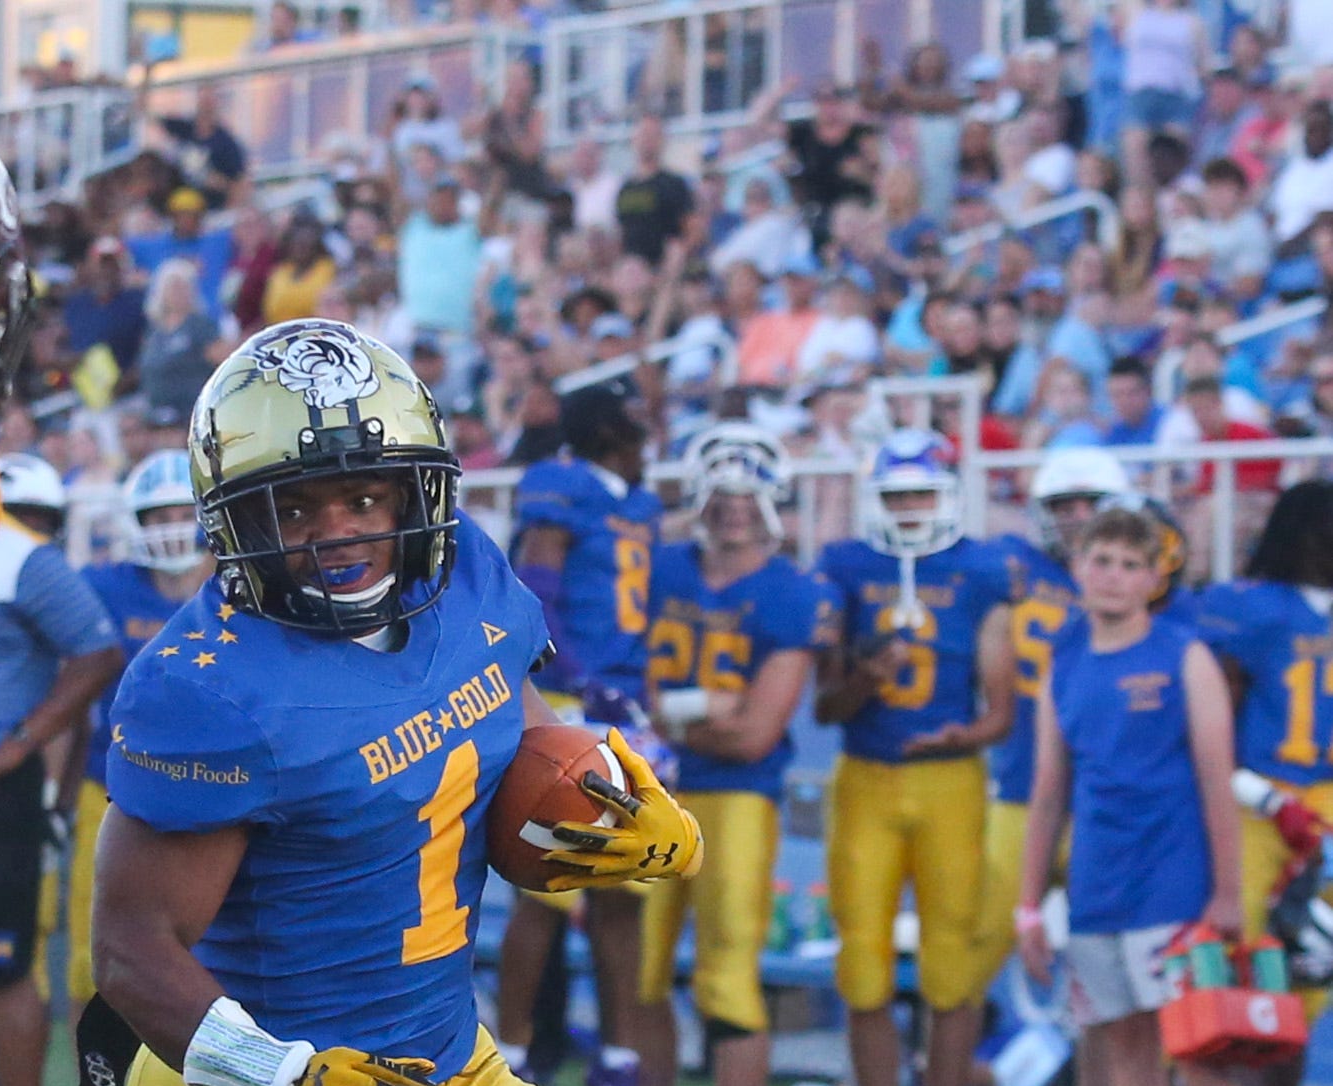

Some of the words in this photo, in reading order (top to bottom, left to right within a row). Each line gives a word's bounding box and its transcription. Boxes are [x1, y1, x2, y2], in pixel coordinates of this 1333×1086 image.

[358, 710, 443, 785] BLUE
[448, 662, 512, 729] GOLD
[1277, 658, 1333, 768] 1
[192, 761, 250, 784] Foods
[401, 739, 480, 966] 1
